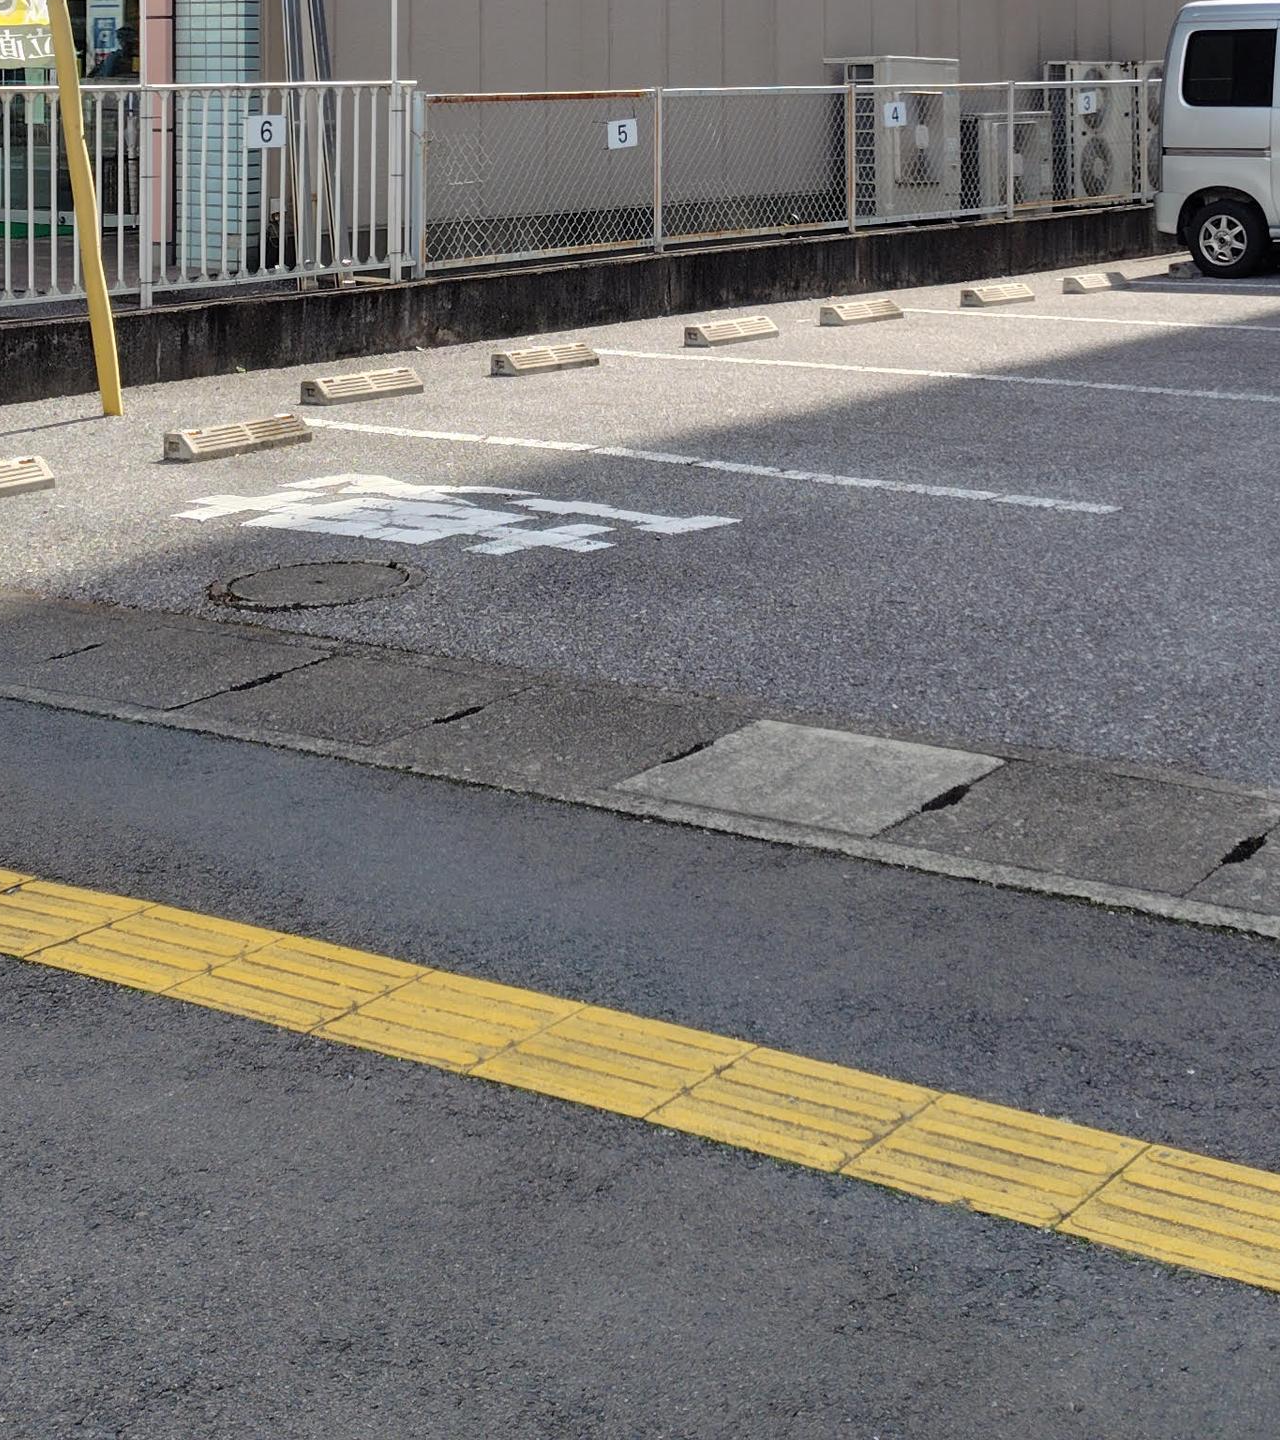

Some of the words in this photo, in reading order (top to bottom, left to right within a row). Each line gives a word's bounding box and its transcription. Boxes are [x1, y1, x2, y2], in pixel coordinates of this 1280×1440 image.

[1083, 95, 1091, 111] 3
[891, 106, 900, 122] 4
[260, 120, 273, 143] 6
[617, 123, 628, 144] 5
